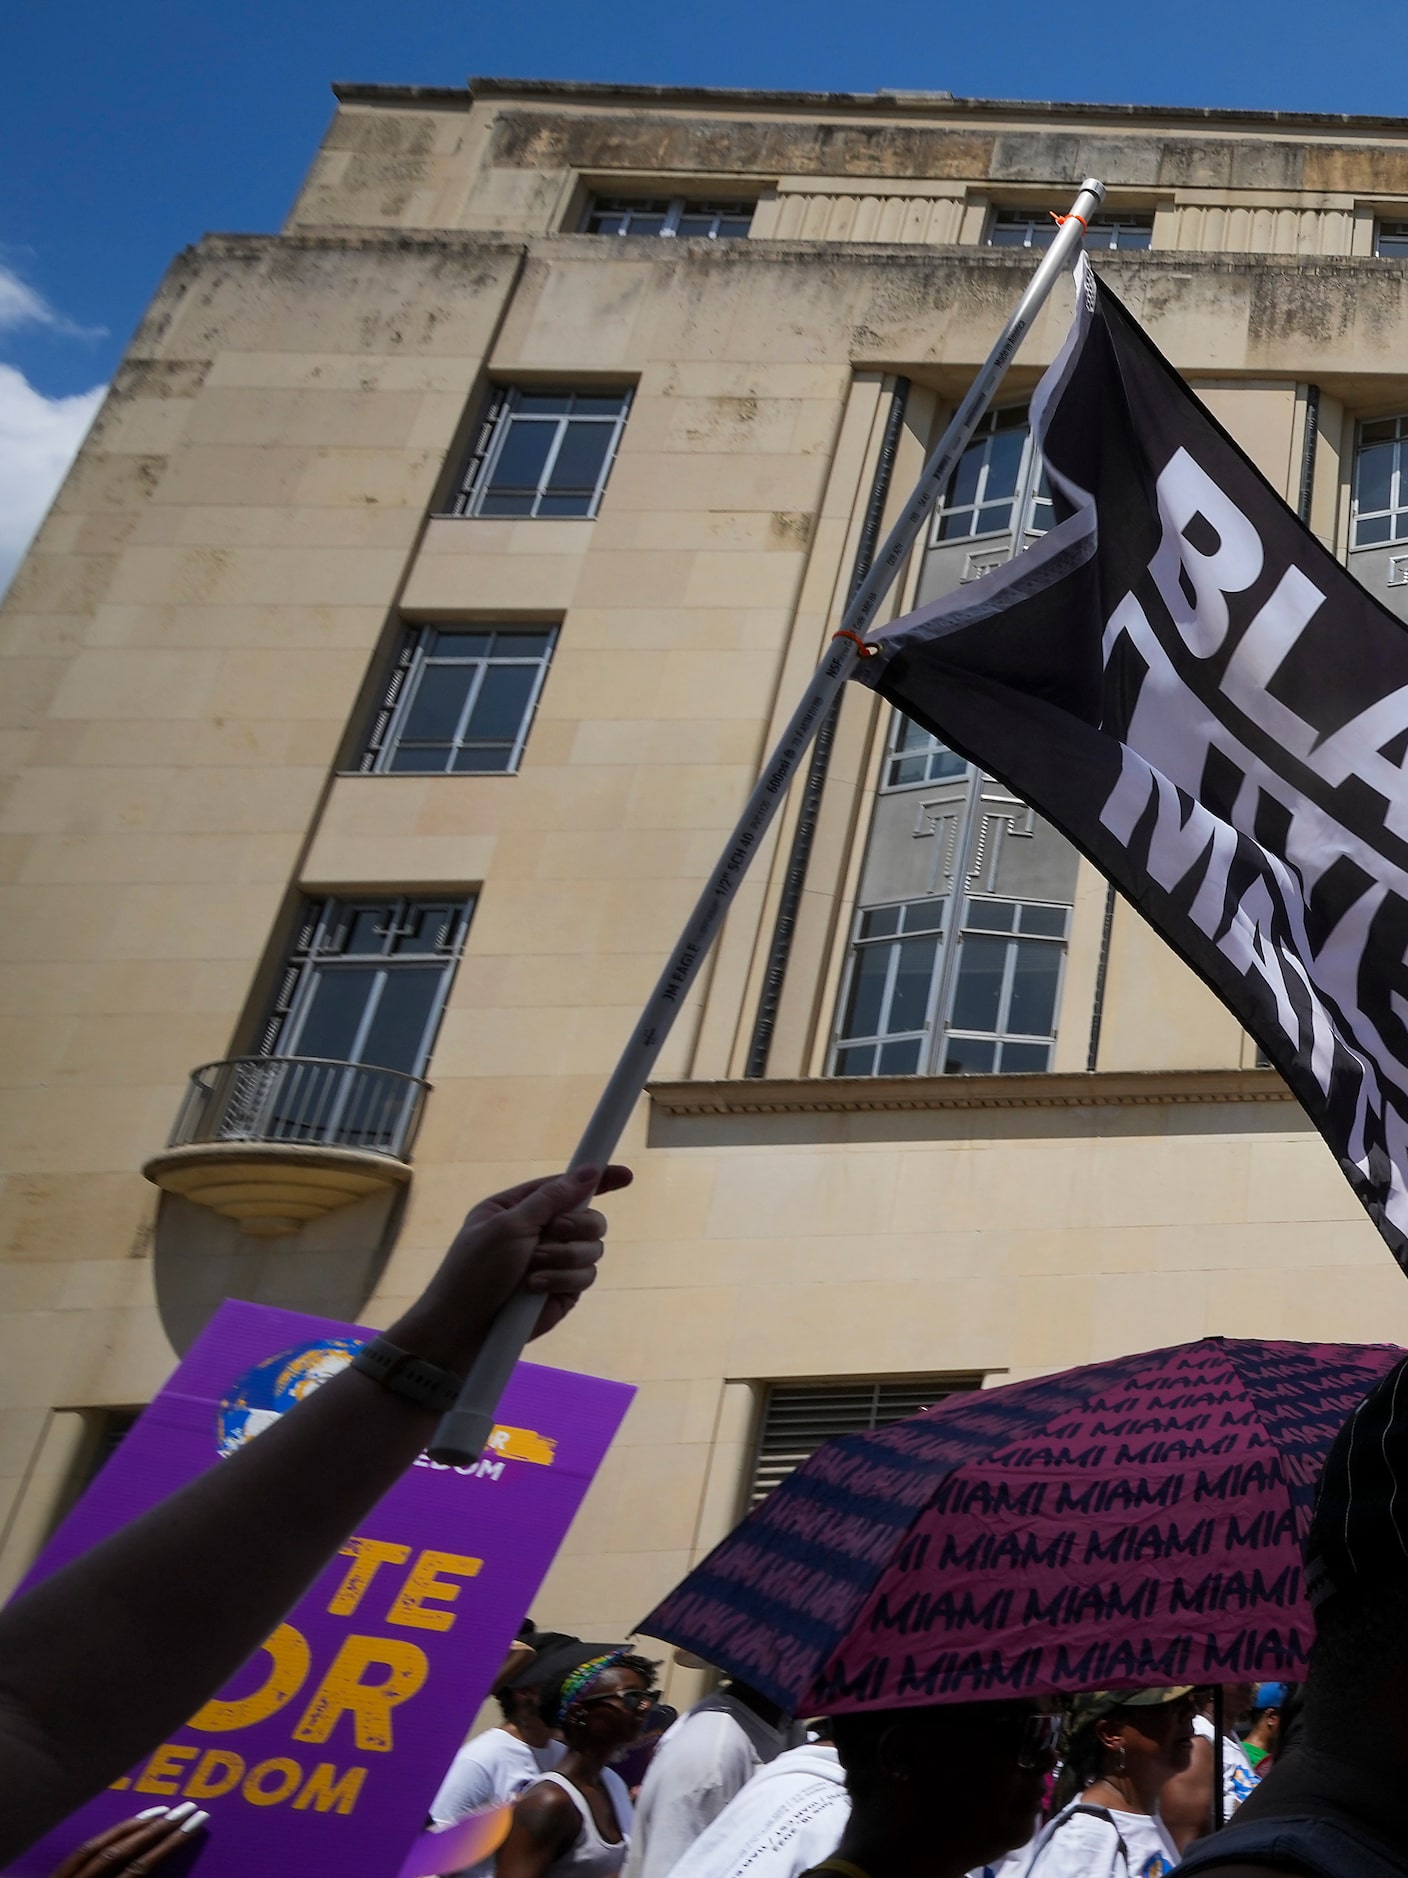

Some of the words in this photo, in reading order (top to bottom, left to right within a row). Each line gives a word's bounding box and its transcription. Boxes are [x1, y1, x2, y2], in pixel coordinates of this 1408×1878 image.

[993, 349, 1009, 368] Made
[672, 943, 699, 982] EAGLE
[727, 847, 747, 872] SCH
[740, 832, 755, 847] 40
[766, 759, 790, 794] 600psi
[1090, 1414, 1213, 1438] MIAMI
[1146, 1390, 1250, 1411] MIAM
[1115, 1433, 1239, 1465] MIAMI
[1056, 1473, 1185, 1514] MIAMI
[938, 1531, 1076, 1572] MIAMI
[1084, 1518, 1216, 1566] MIAMI
[1225, 1507, 1300, 1551] MIA
[870, 1588, 1014, 1635] MIAMI
[1022, 1577, 1160, 1627] MIAMI
[1168, 1565, 1300, 1614] MIAMI
[184, 1622, 430, 1753] OR
[896, 1647, 1043, 1697] MIAMI
[1051, 1636, 1192, 1684] MIAMI
[1202, 1627, 1313, 1673] MIAM
